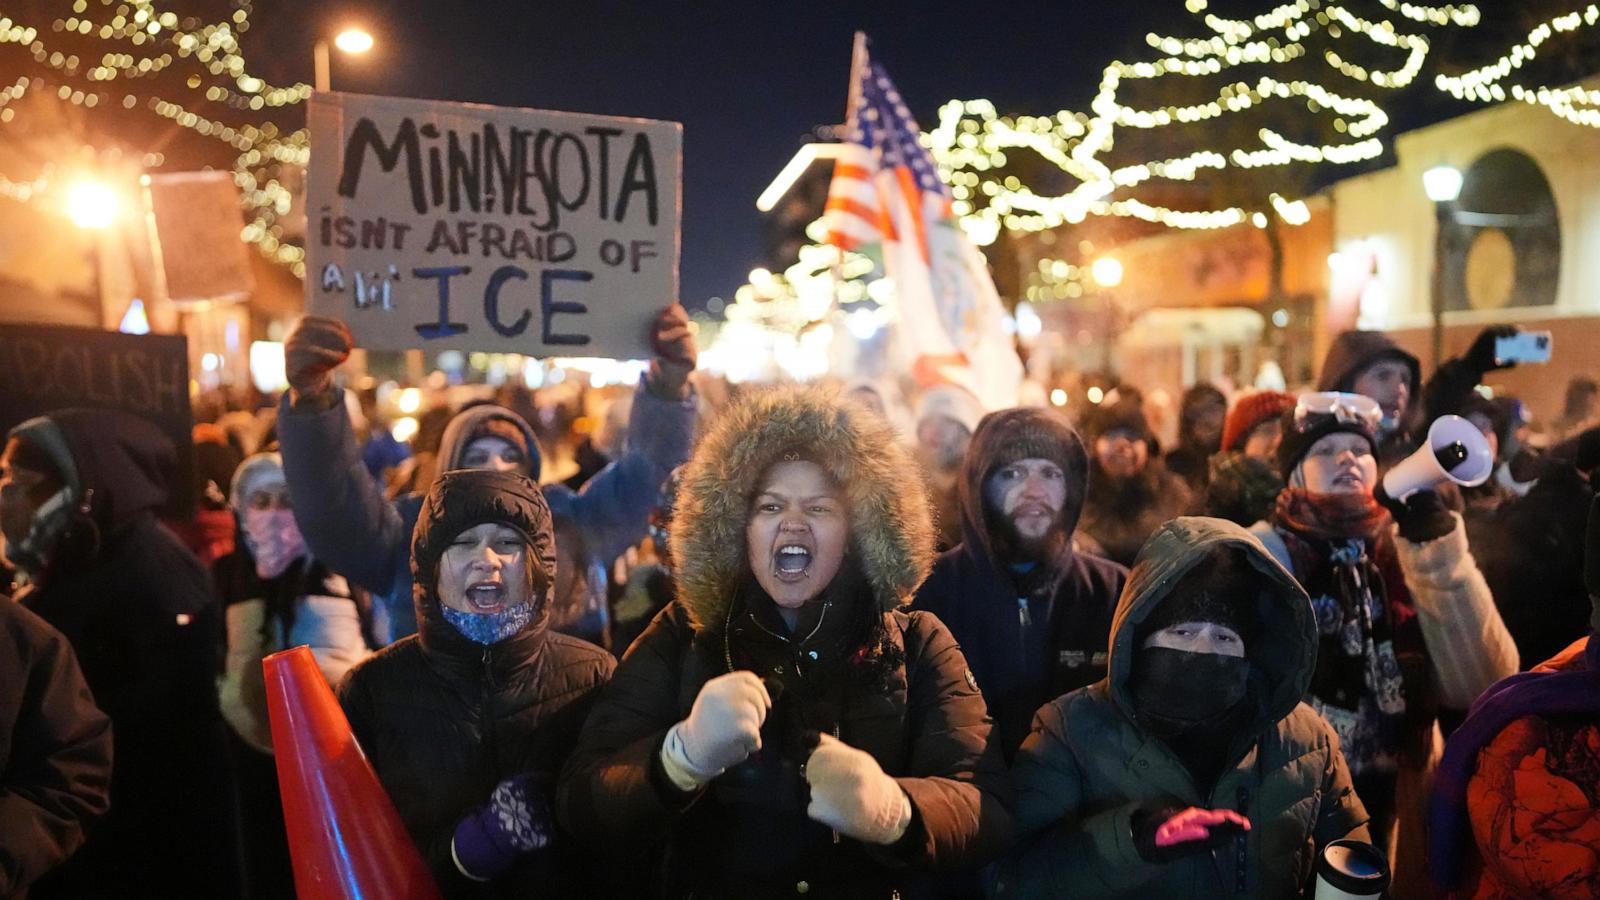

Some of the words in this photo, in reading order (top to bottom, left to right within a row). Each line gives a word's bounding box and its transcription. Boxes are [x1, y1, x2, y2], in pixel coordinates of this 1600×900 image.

[424, 219, 578, 264] AFRAID
[599, 238, 659, 274] OF
[412, 264, 595, 346] ICE
